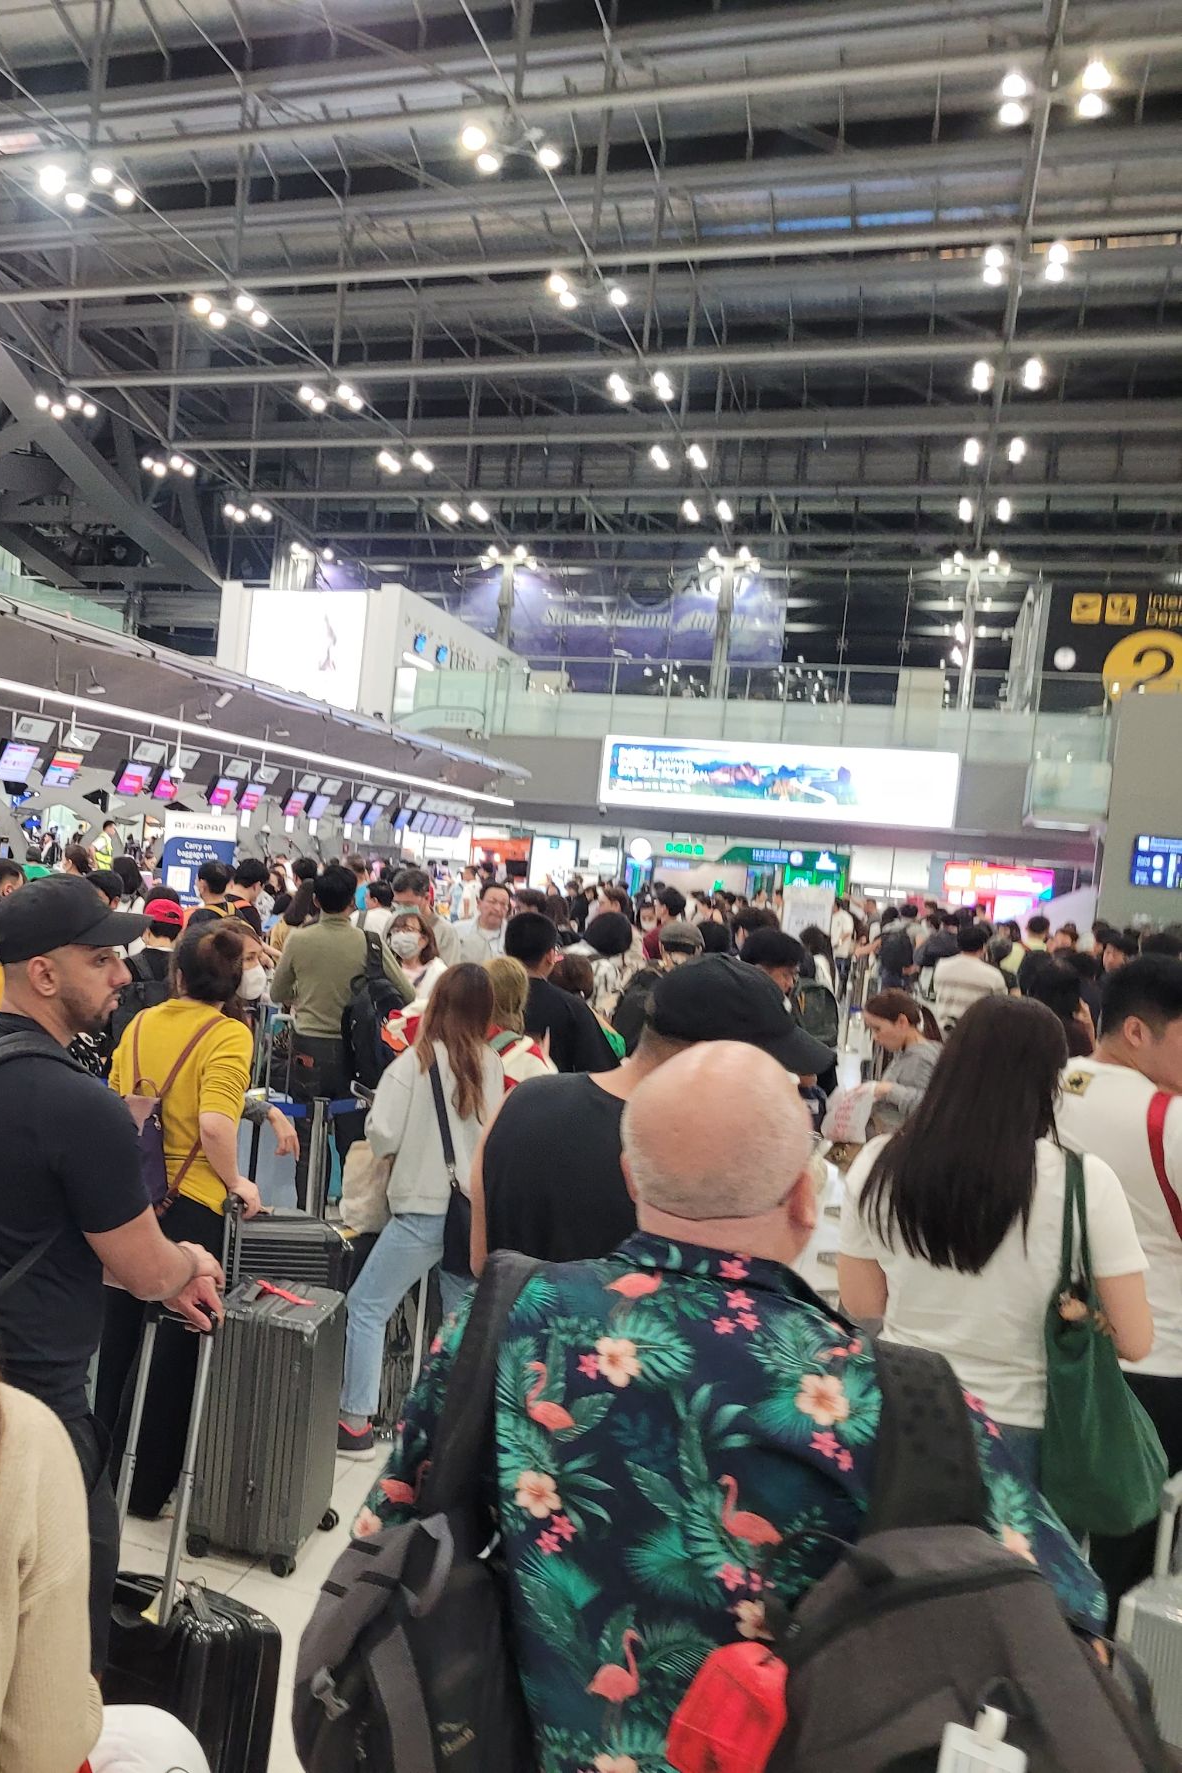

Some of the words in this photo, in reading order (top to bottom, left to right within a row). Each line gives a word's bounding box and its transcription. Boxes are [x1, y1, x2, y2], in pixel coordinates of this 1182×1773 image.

[184, 841, 202, 851] Carry
[203, 843, 212, 851] on
[176, 848, 205, 860] baggage
[205, 850, 218, 860] rule
